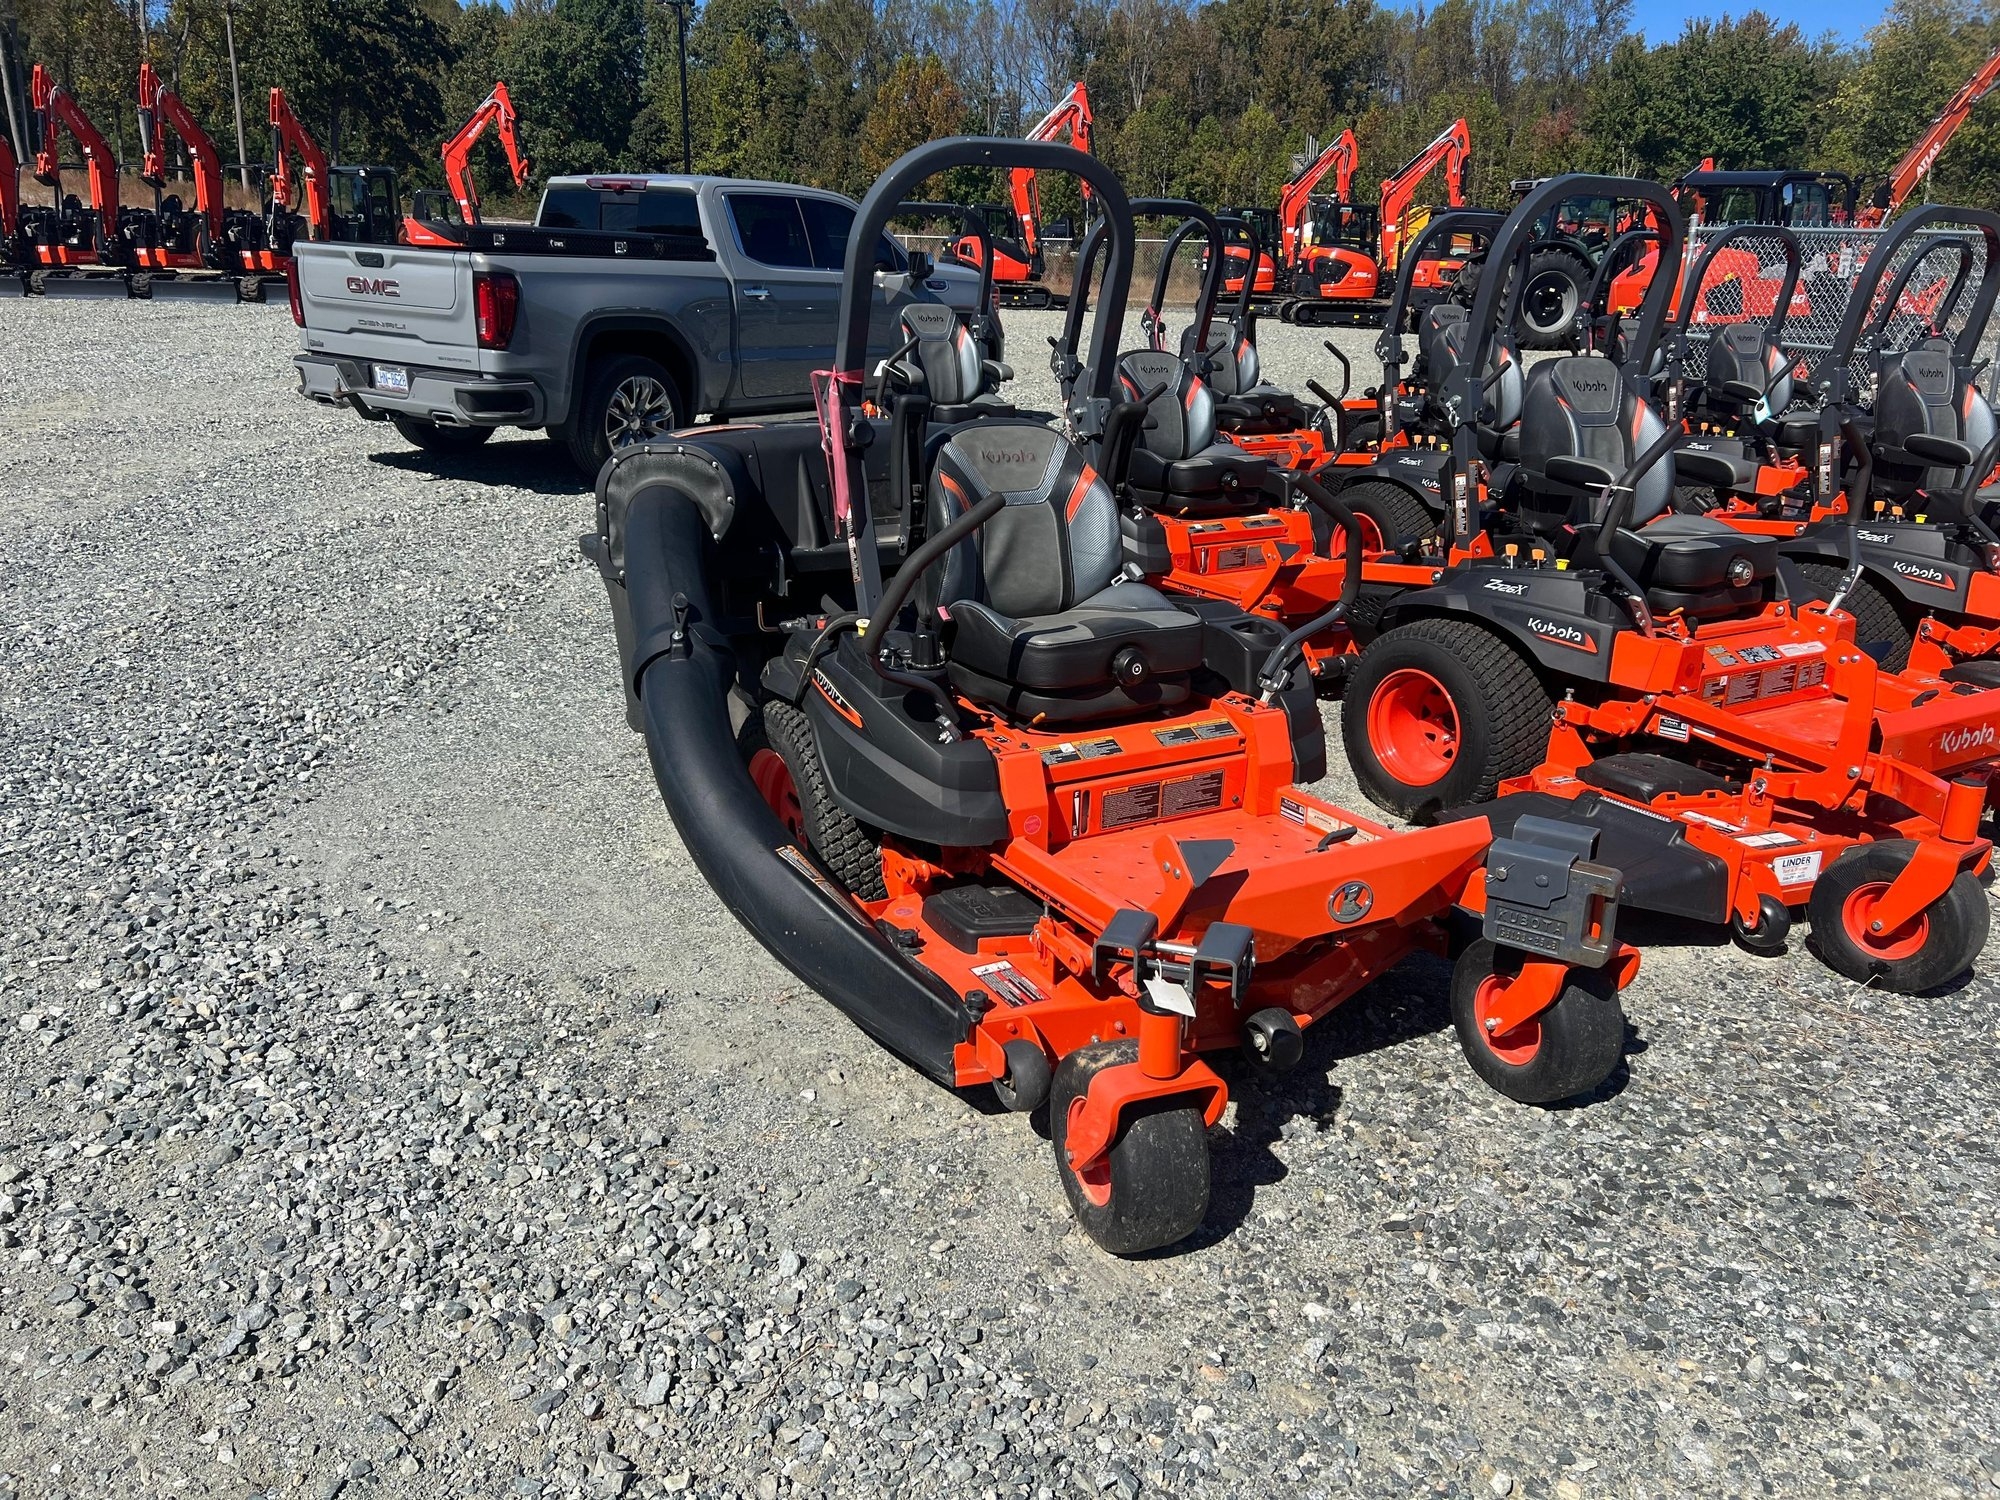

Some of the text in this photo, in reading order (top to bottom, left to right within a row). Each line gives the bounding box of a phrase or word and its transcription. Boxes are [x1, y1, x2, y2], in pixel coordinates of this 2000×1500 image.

[1916, 141, 1941, 178] ATLAS
[346, 276, 401, 297] GMC
[358, 319, 407, 330] DENALI
[917, 314, 944, 322] Kubota
[1140, 364, 1169, 374] Kubota
[1919, 368, 1944, 378] Kubota
[1573, 379, 1607, 392] Kubota
[981, 449, 1037, 464] Kubota
[1893, 561, 1943, 581] Kubota
[1528, 618, 1582, 642] Kubota
[1940, 722, 1995, 753] Kubota
[1782, 856, 1812, 868] LINDER
[1497, 908, 1562, 936] KUBOTA
